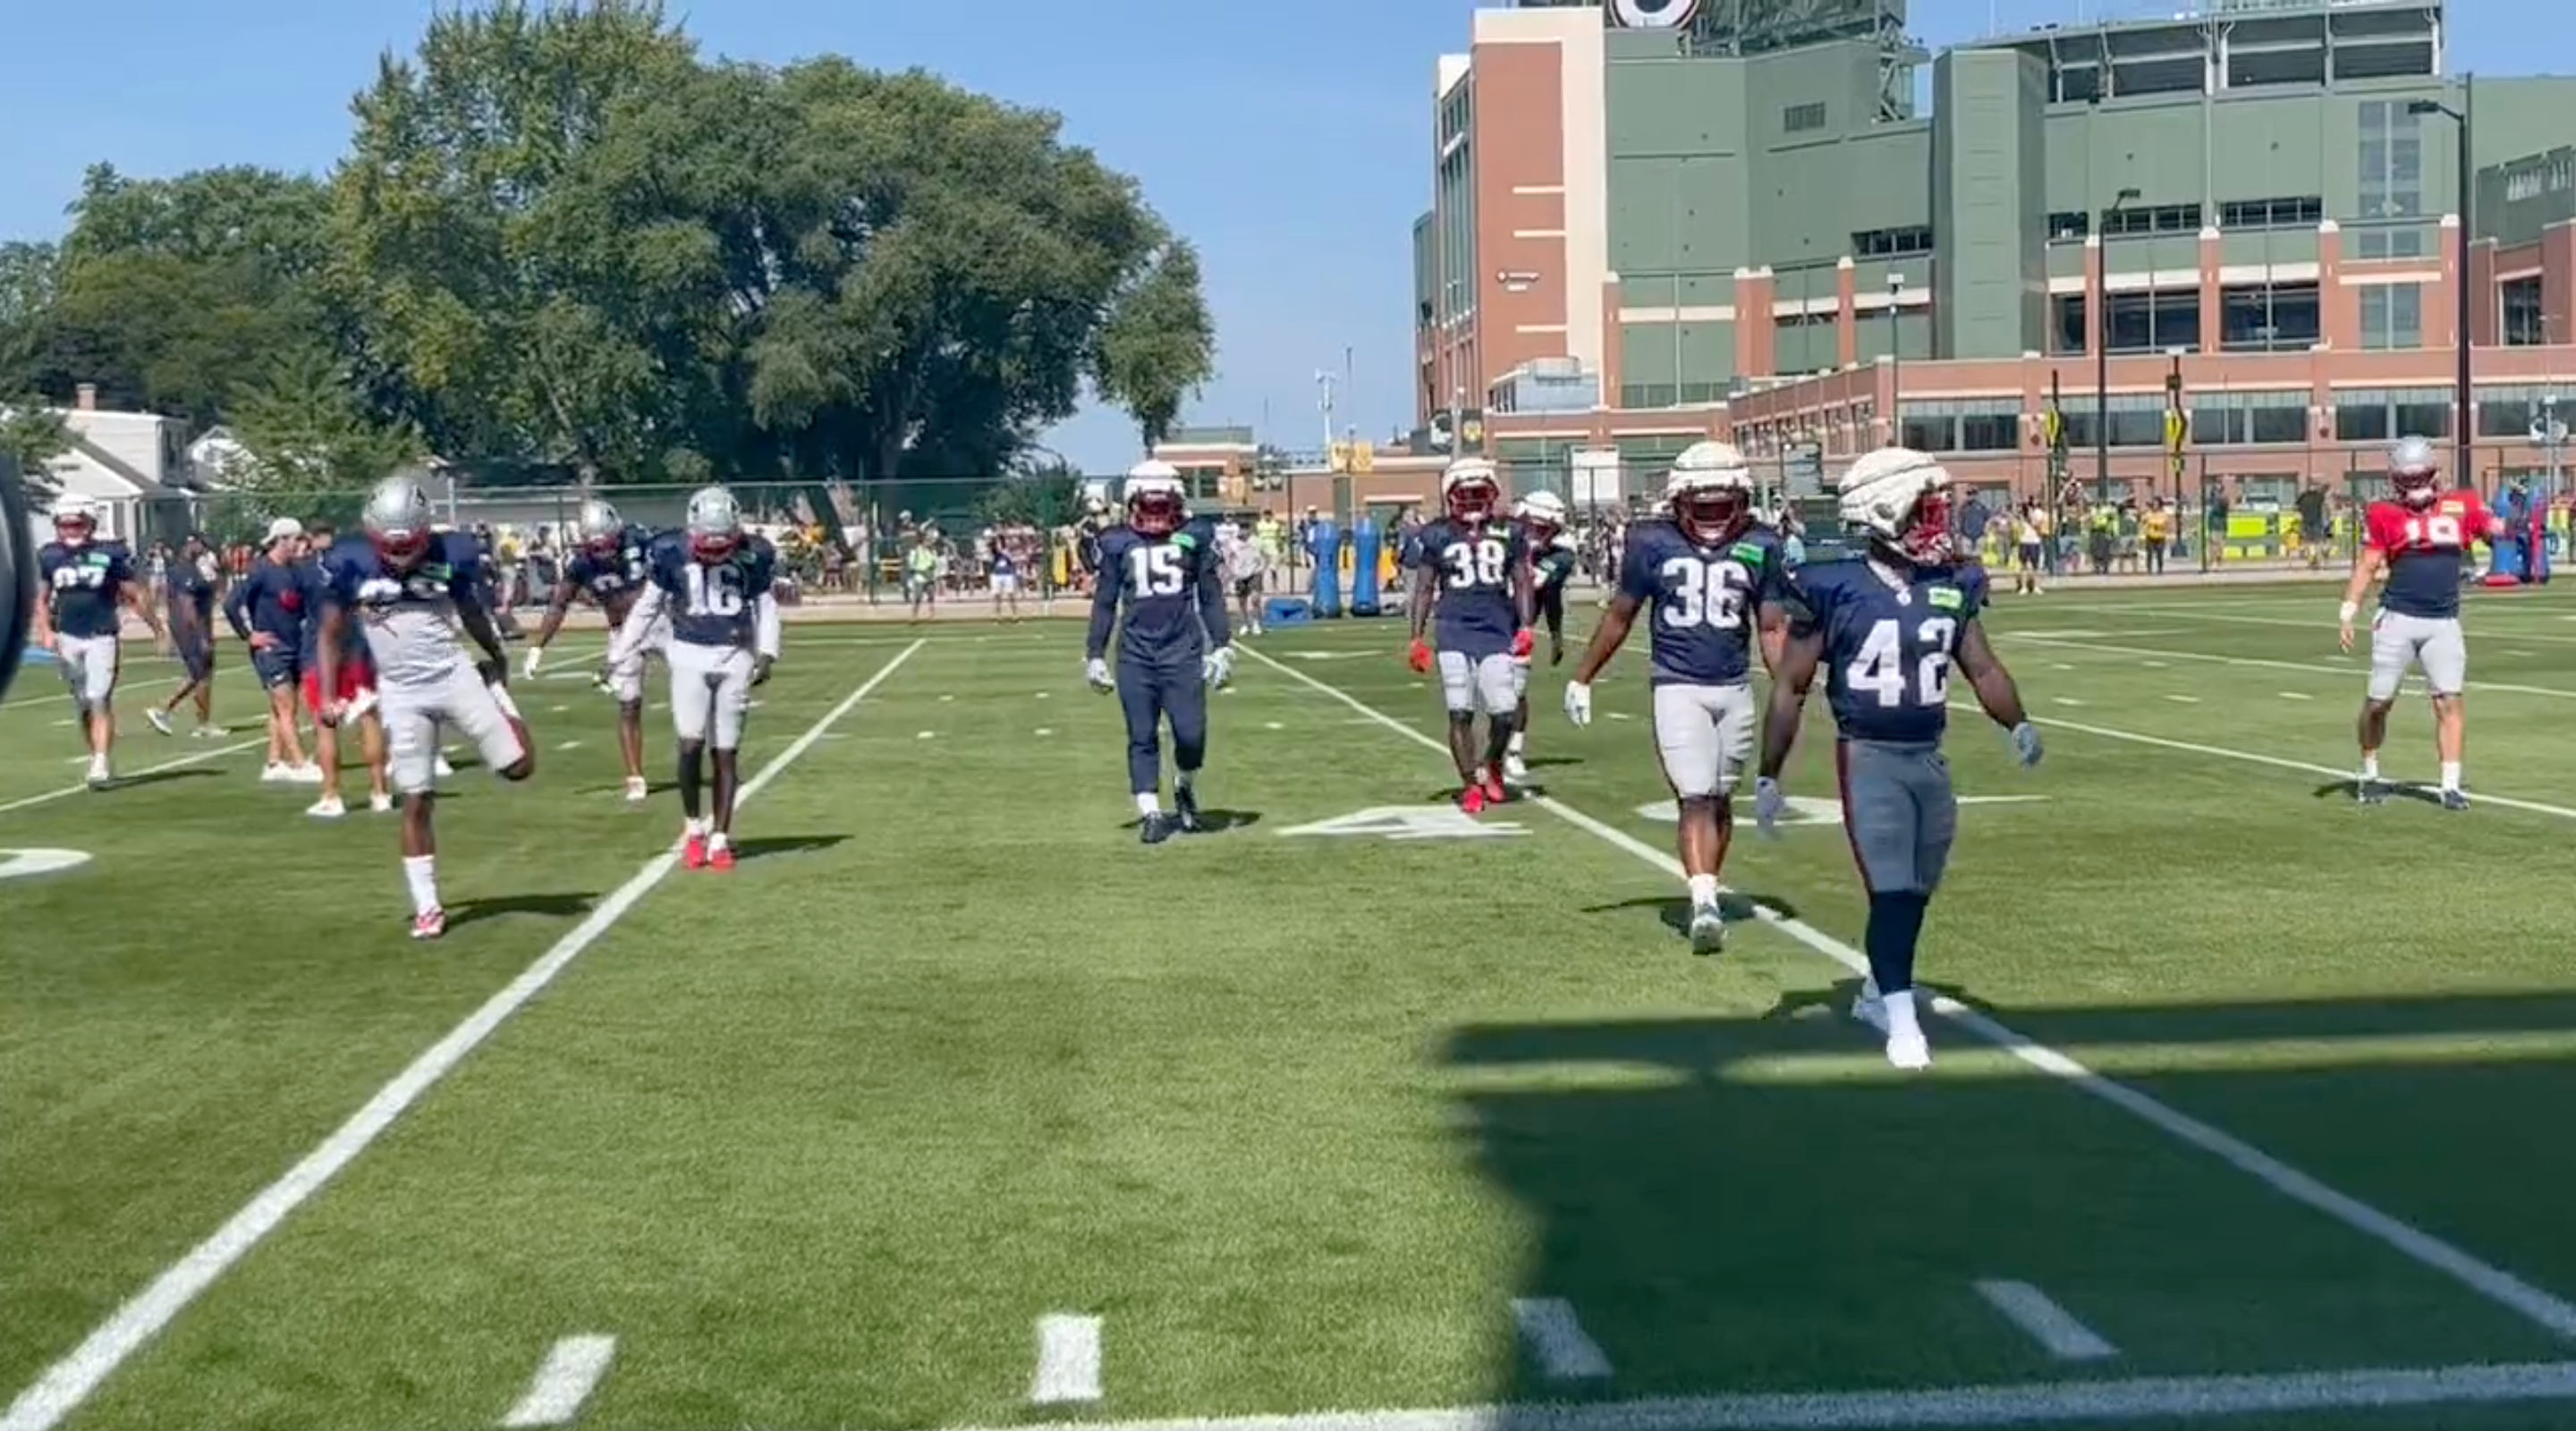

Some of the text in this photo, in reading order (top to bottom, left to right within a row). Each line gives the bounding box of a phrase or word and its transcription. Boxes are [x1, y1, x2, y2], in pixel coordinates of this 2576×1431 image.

[684, 563, 743, 616] 16
[1130, 544, 1184, 597] 15
[1443, 539, 1506, 588] 38
[1662, 556, 1750, 629] 36
[1846, 617, 1956, 707] 42
